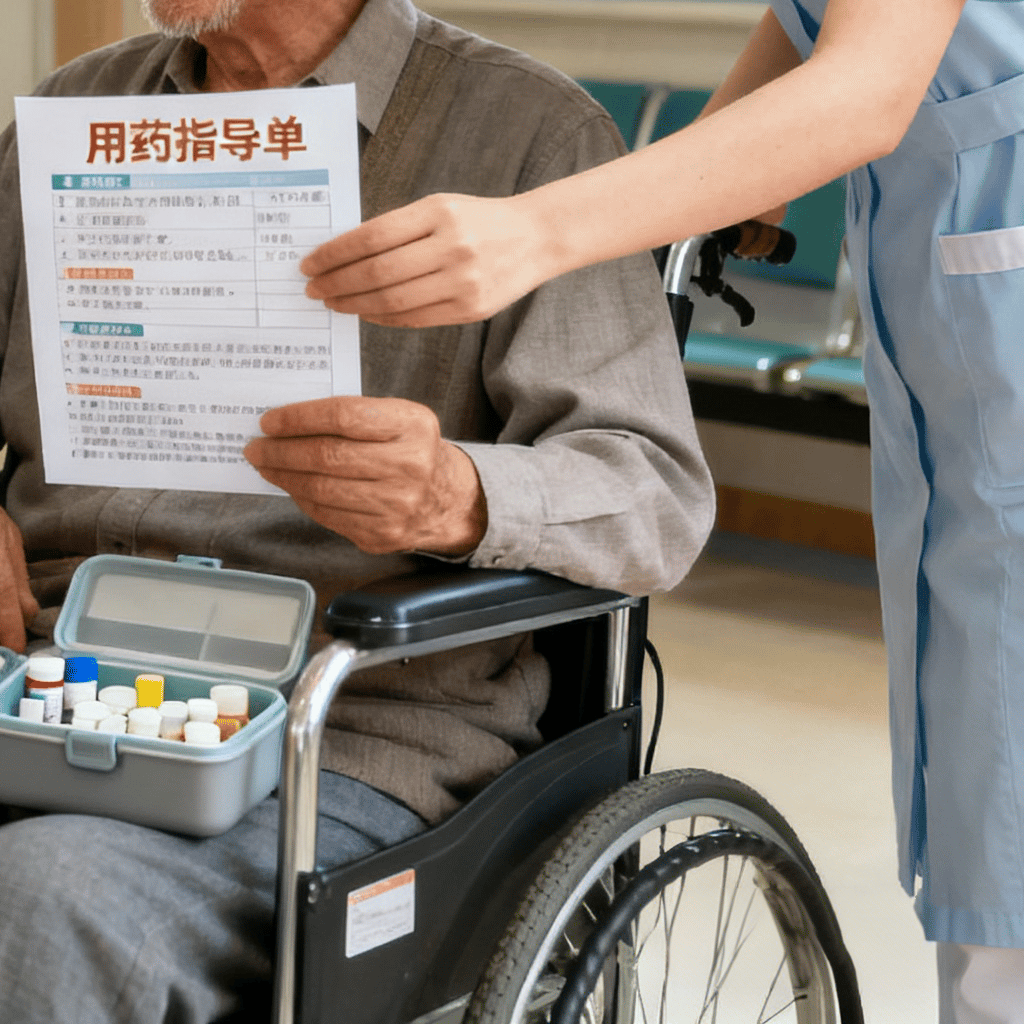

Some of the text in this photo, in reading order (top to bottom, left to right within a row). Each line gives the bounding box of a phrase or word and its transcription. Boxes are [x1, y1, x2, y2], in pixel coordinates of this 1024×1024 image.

[87, 115, 307, 163] 用药指导单
